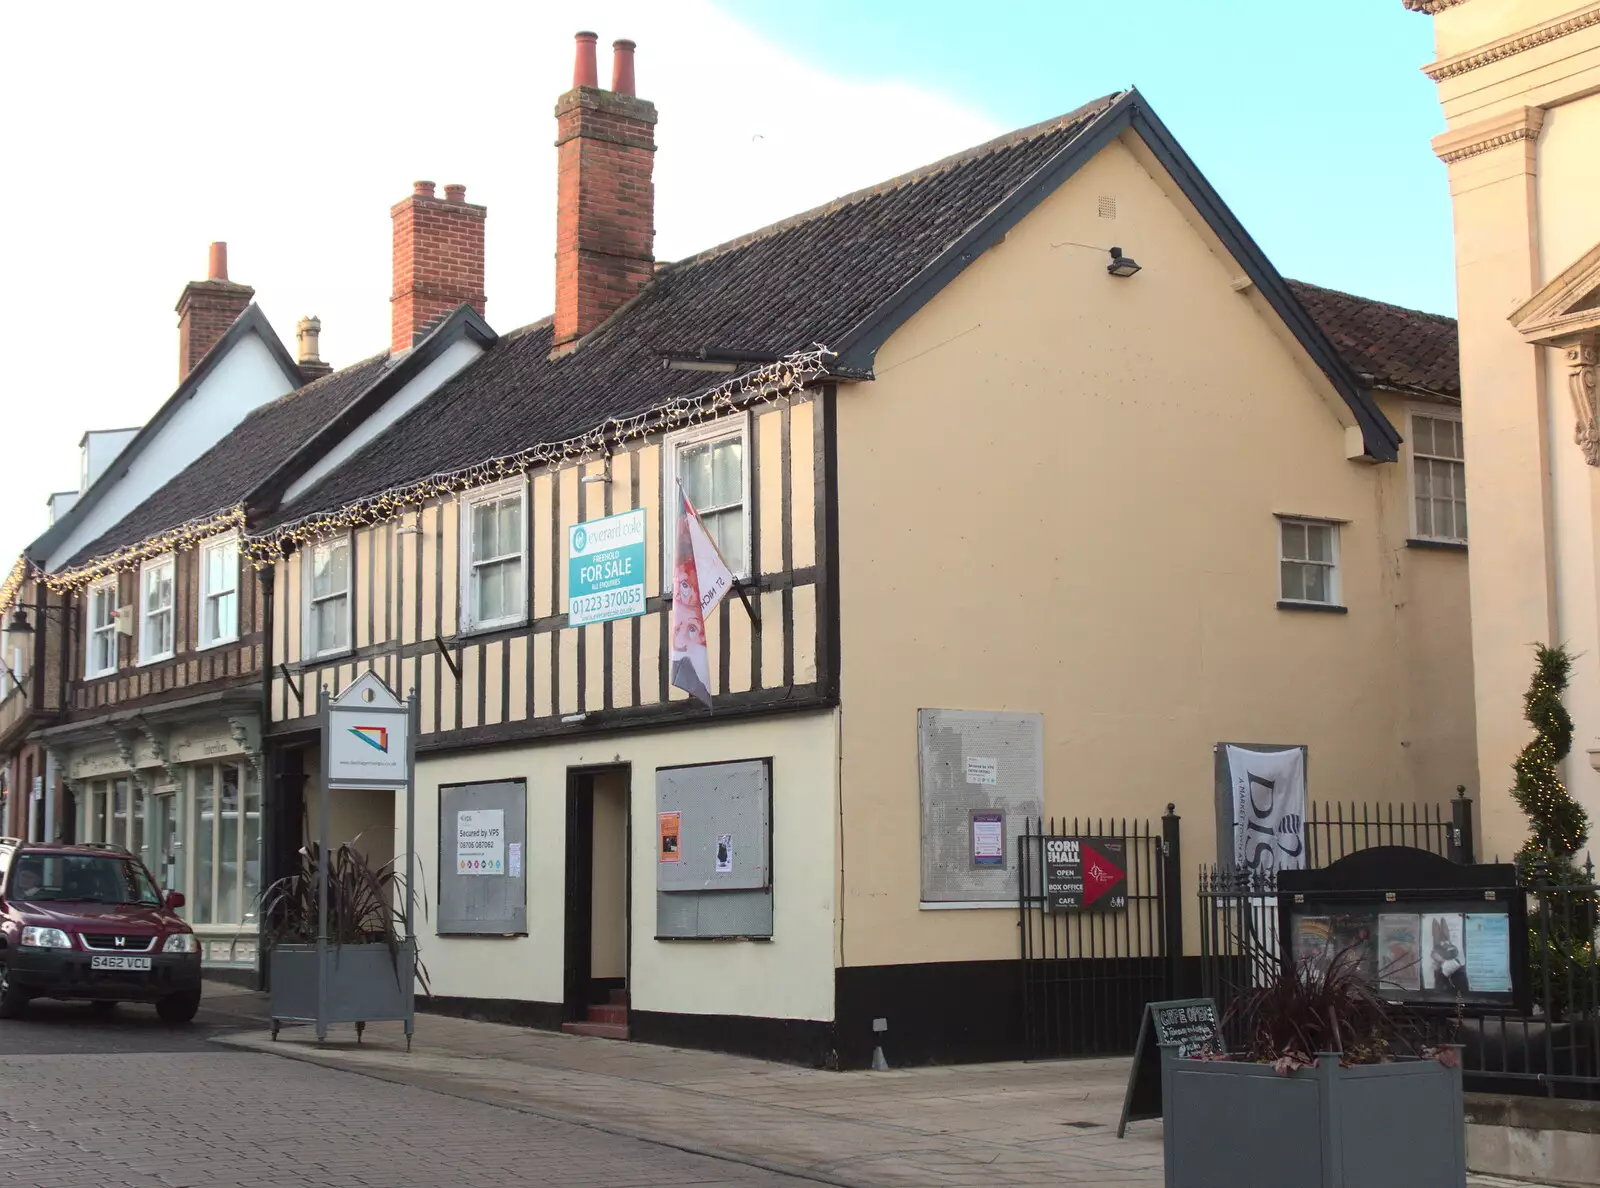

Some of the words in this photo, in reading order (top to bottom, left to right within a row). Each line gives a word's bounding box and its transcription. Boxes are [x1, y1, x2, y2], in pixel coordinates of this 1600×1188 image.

[588, 519, 620, 545] everard
[622, 516, 641, 536] cole
[592, 550, 619, 563] FREEHOLD
[580, 563, 603, 584] FOR
[604, 557, 632, 579] SALE
[572, 595, 602, 615] 01223
[604, 587, 641, 609] 370055
[460, 829, 480, 838] Secured
[480, 828, 488, 838] by
[488, 828, 500, 836] VPS
[1047, 840, 1080, 852] CORN
[1052, 852, 1080, 862] HALL
[92, 956, 124, 968] S462
[127, 958, 149, 969] VCL
[1160, 1008, 1188, 1026] CAFE
[1186, 1006, 1208, 1022] OPEN
